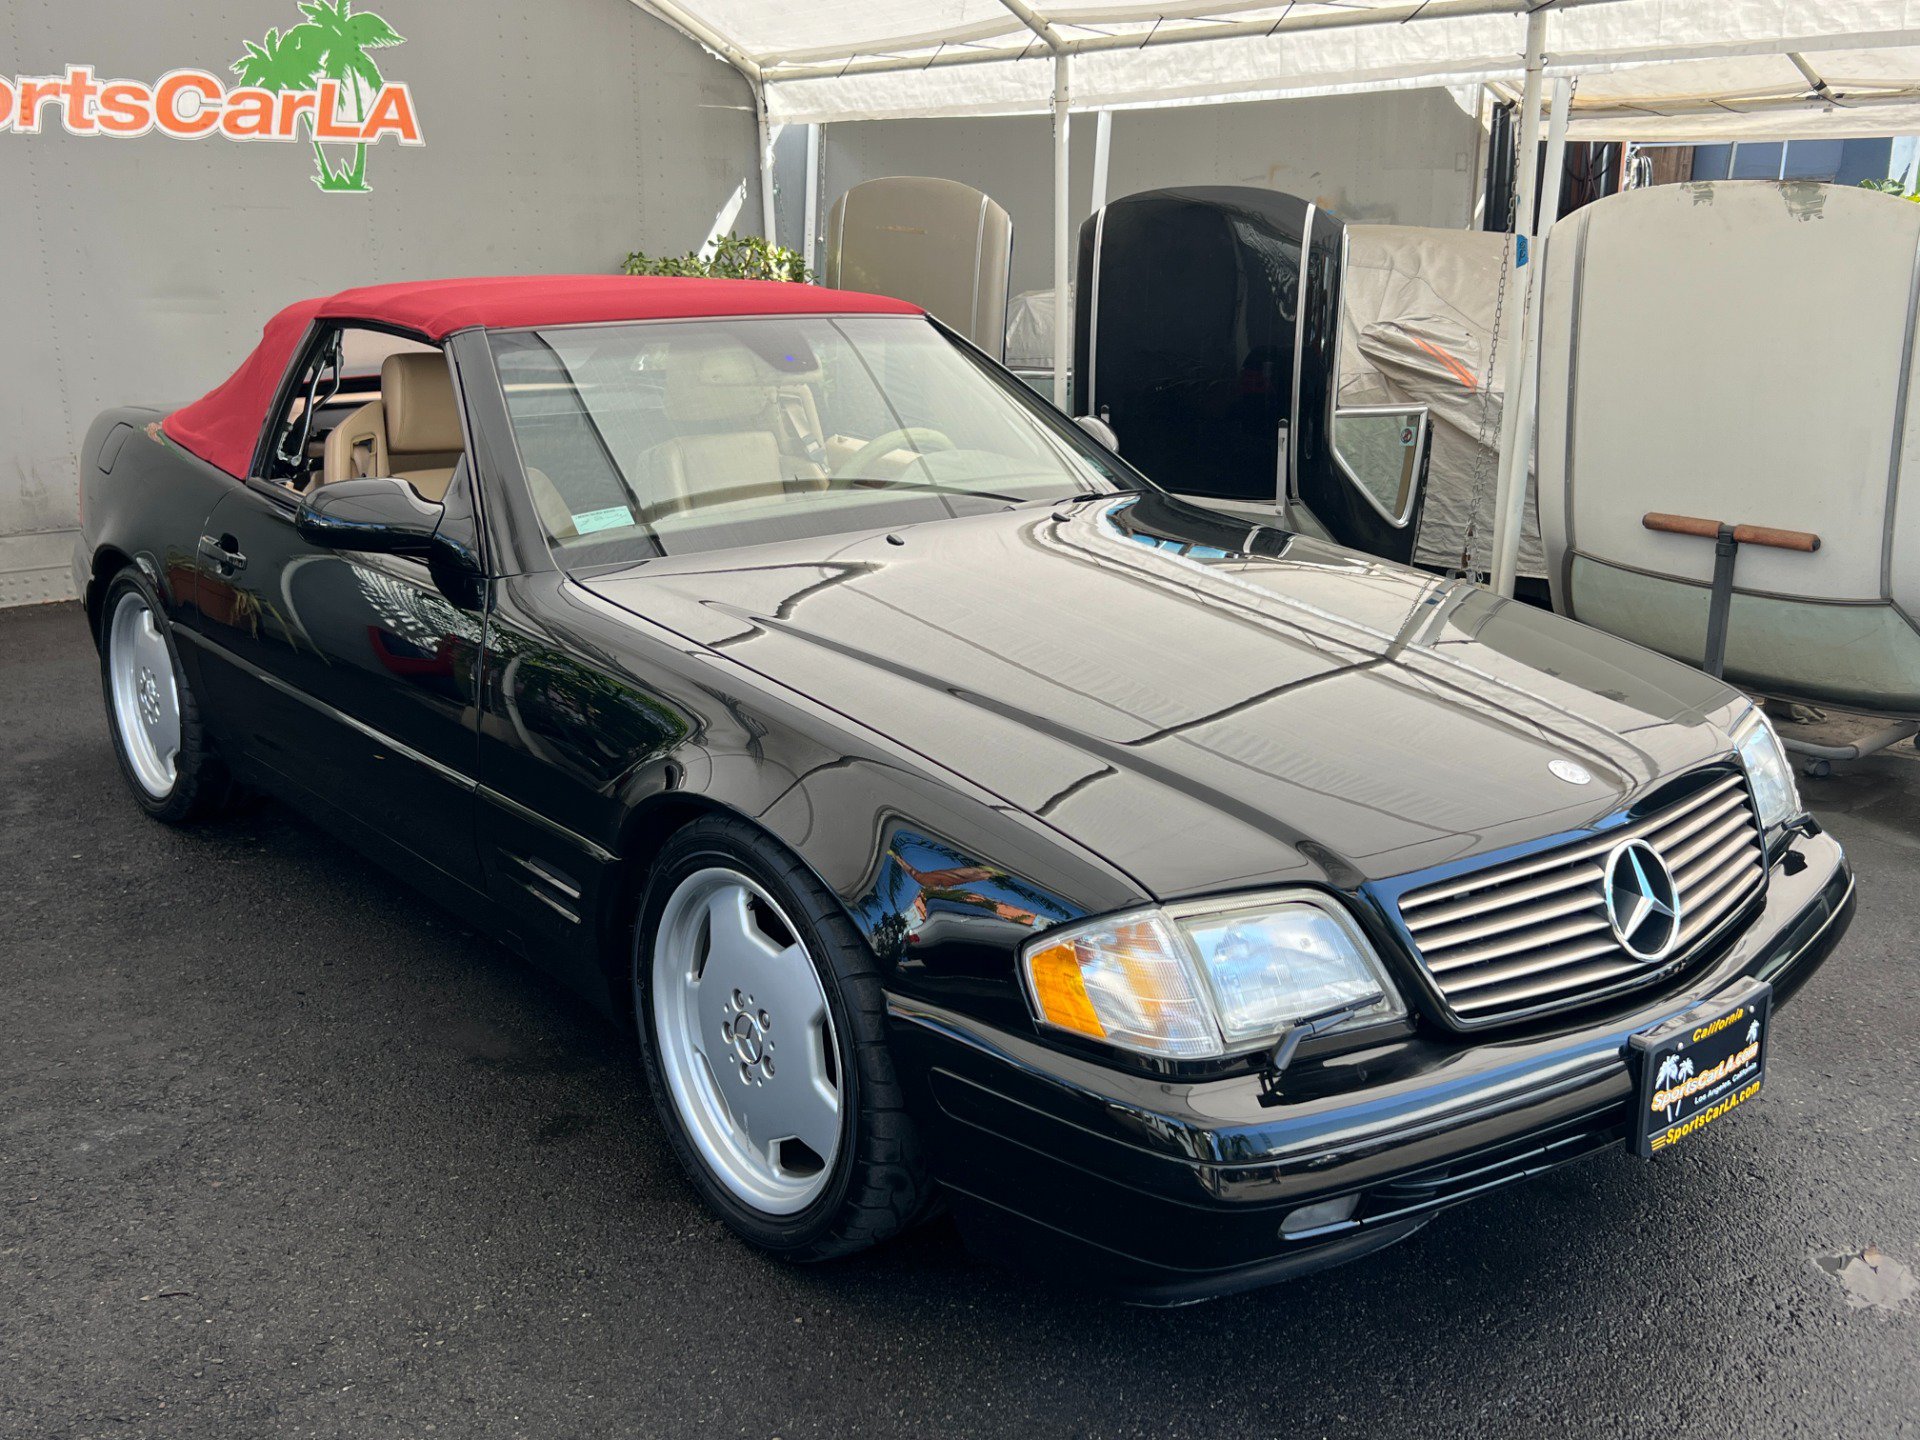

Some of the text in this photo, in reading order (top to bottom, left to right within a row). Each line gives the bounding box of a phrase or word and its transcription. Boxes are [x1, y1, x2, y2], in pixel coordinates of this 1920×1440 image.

[0, 71, 419, 140] rtsCarLA
[1692, 1008, 1744, 1042] California
[1651, 1042, 1759, 1112] SportsCarLA.com
[1694, 1094, 1707, 1105] Los
[1665, 1080, 1760, 1144] SportsCarLA.com
